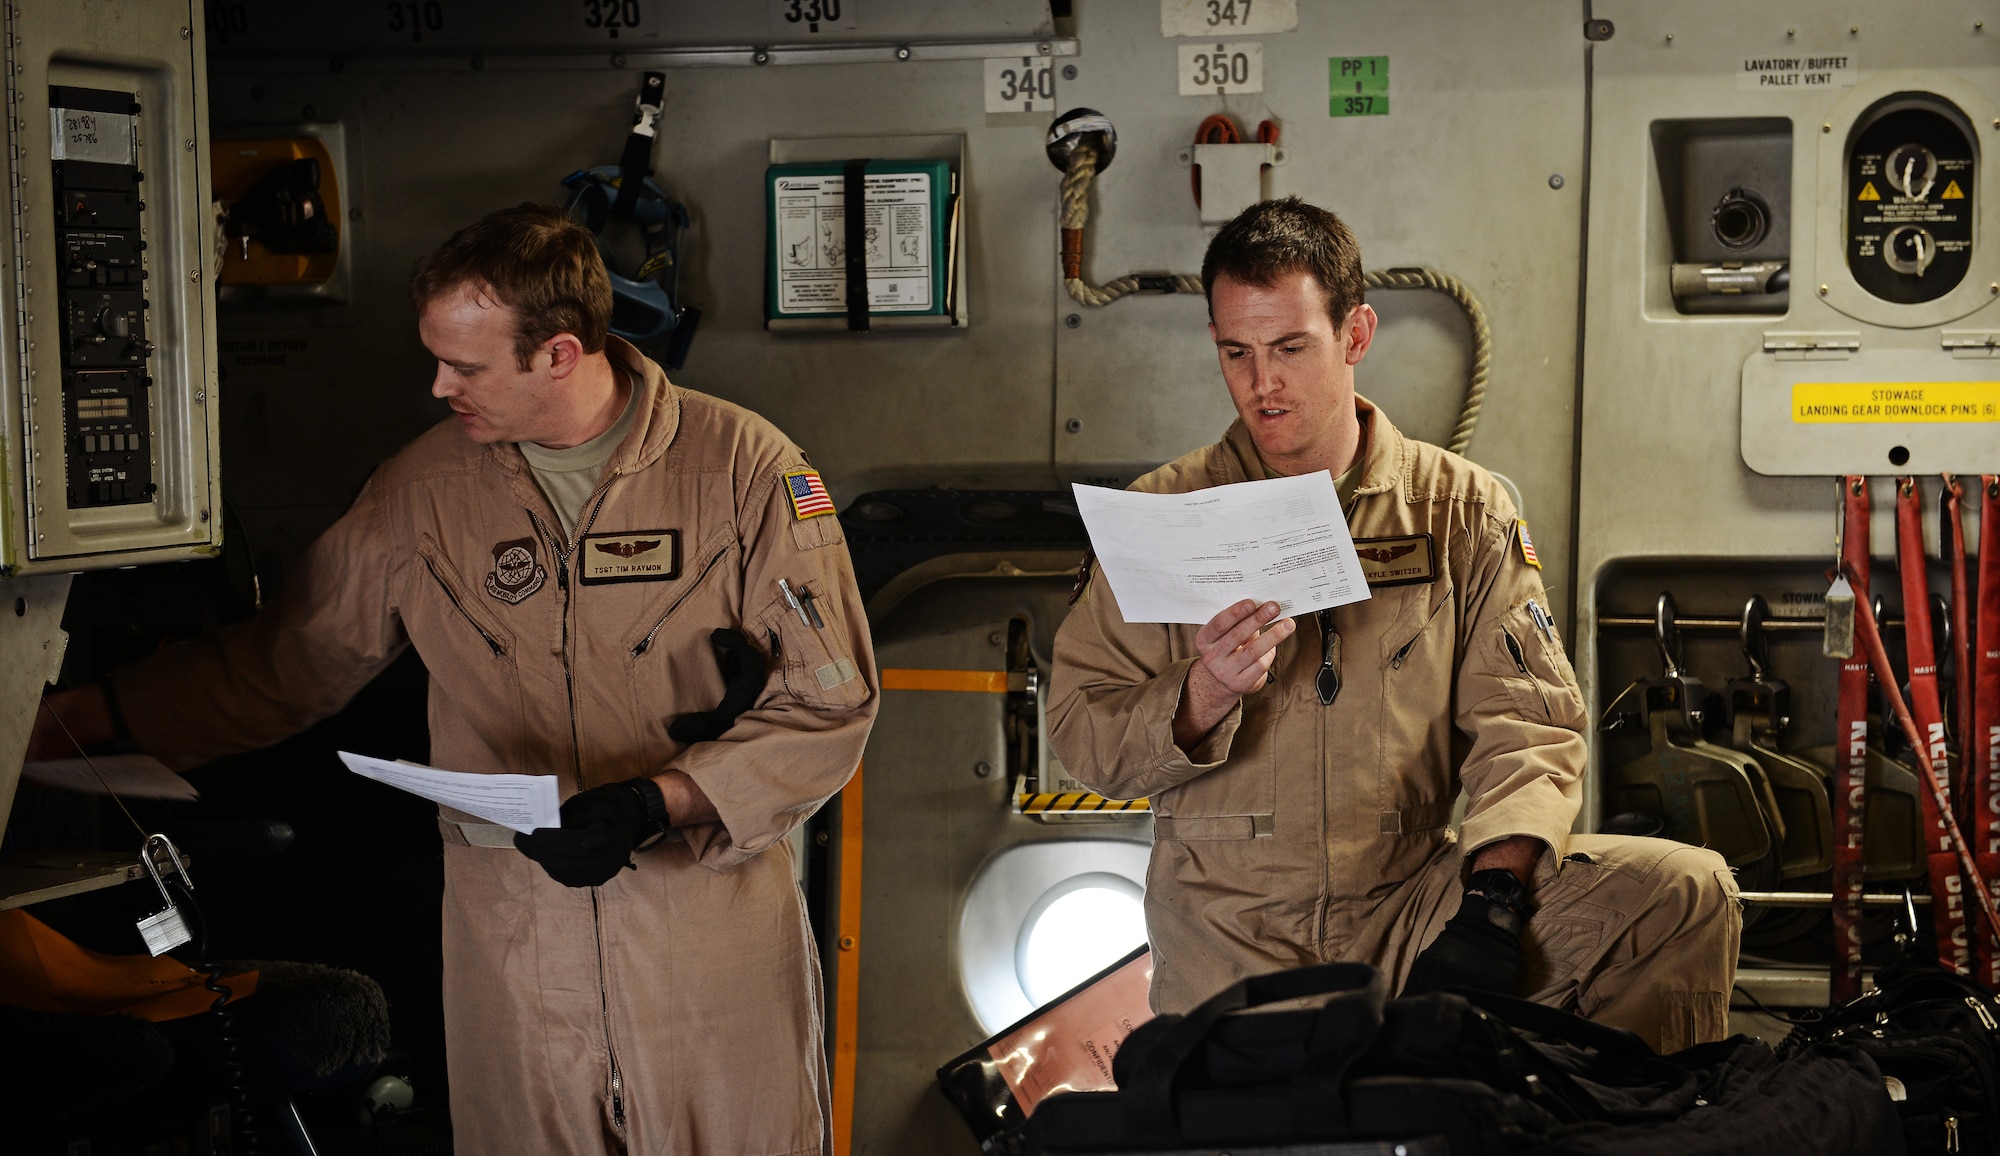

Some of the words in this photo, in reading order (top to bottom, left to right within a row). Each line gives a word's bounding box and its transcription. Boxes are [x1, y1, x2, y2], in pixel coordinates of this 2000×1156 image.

[386, 1, 443, 31] 310
[585, 0, 641, 28] 320
[784, 0, 841, 23] 330
[1207, 0, 1252, 26] 347
[1193, 53, 1249, 86] 350
[1341, 60, 1362, 77] PP
[1368, 60, 1377, 76] 1
[1744, 57, 1848, 71] LAVATORY/BUFFET
[1000, 68, 1055, 100] 340
[1760, 74, 1800, 86] PALLET
[1804, 73, 1831, 85] VENT
[1344, 97, 1374, 114] 357
[1872, 390, 1924, 401] STOWAGE
[1800, 405, 1848, 416] LANDING
[1852, 405, 1880, 416] GEAR
[1885, 404, 1947, 415] DOWNLOCK
[1952, 404, 1977, 415] PINS
[595, 566, 613, 574] TSGT
[616, 565, 629, 573] TIM
[631, 564, 662, 574] RAYMON
[1389, 568, 1422, 577] SWITZER
[518, 576, 542, 598] COMMAND
